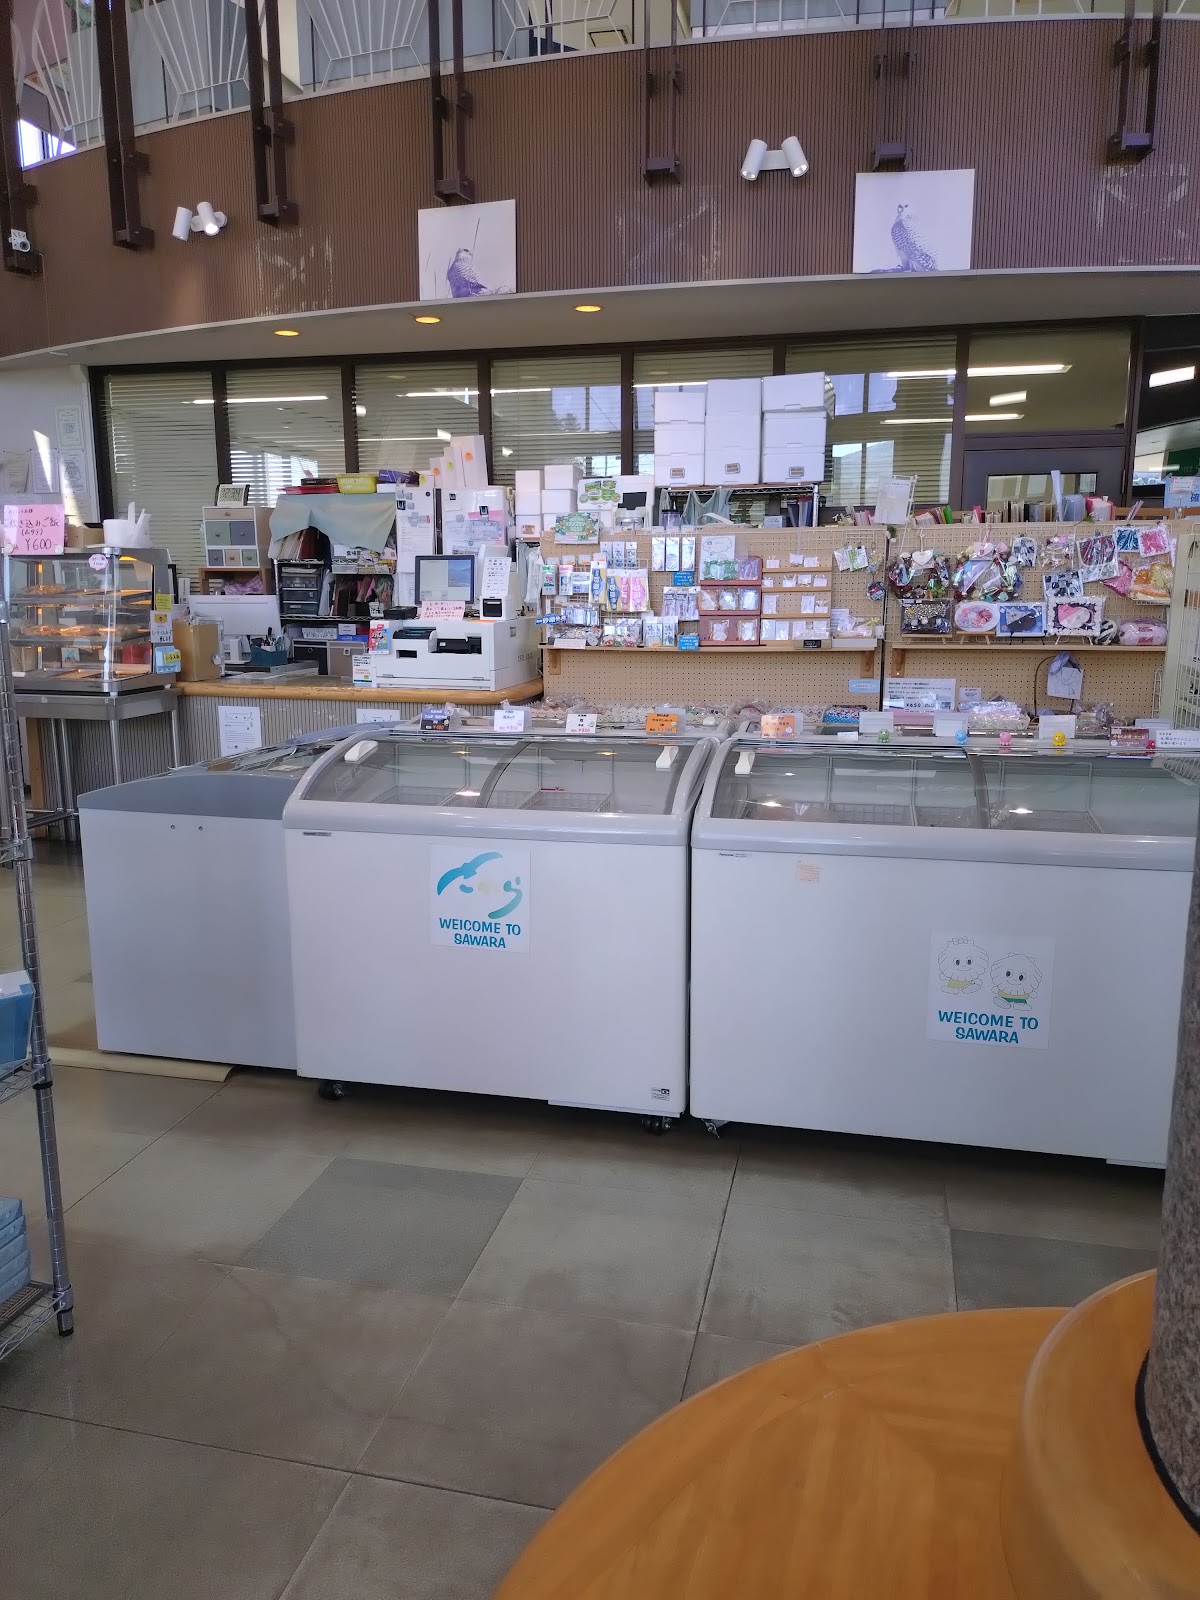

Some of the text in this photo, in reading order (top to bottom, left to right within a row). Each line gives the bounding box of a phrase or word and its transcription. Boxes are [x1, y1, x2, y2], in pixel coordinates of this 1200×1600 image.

[506, 923, 522, 936] TO
[454, 932, 506, 949] SAWARA
[1019, 1016, 1039, 1030] TO
[955, 1026, 1019, 1044] SAWARA
